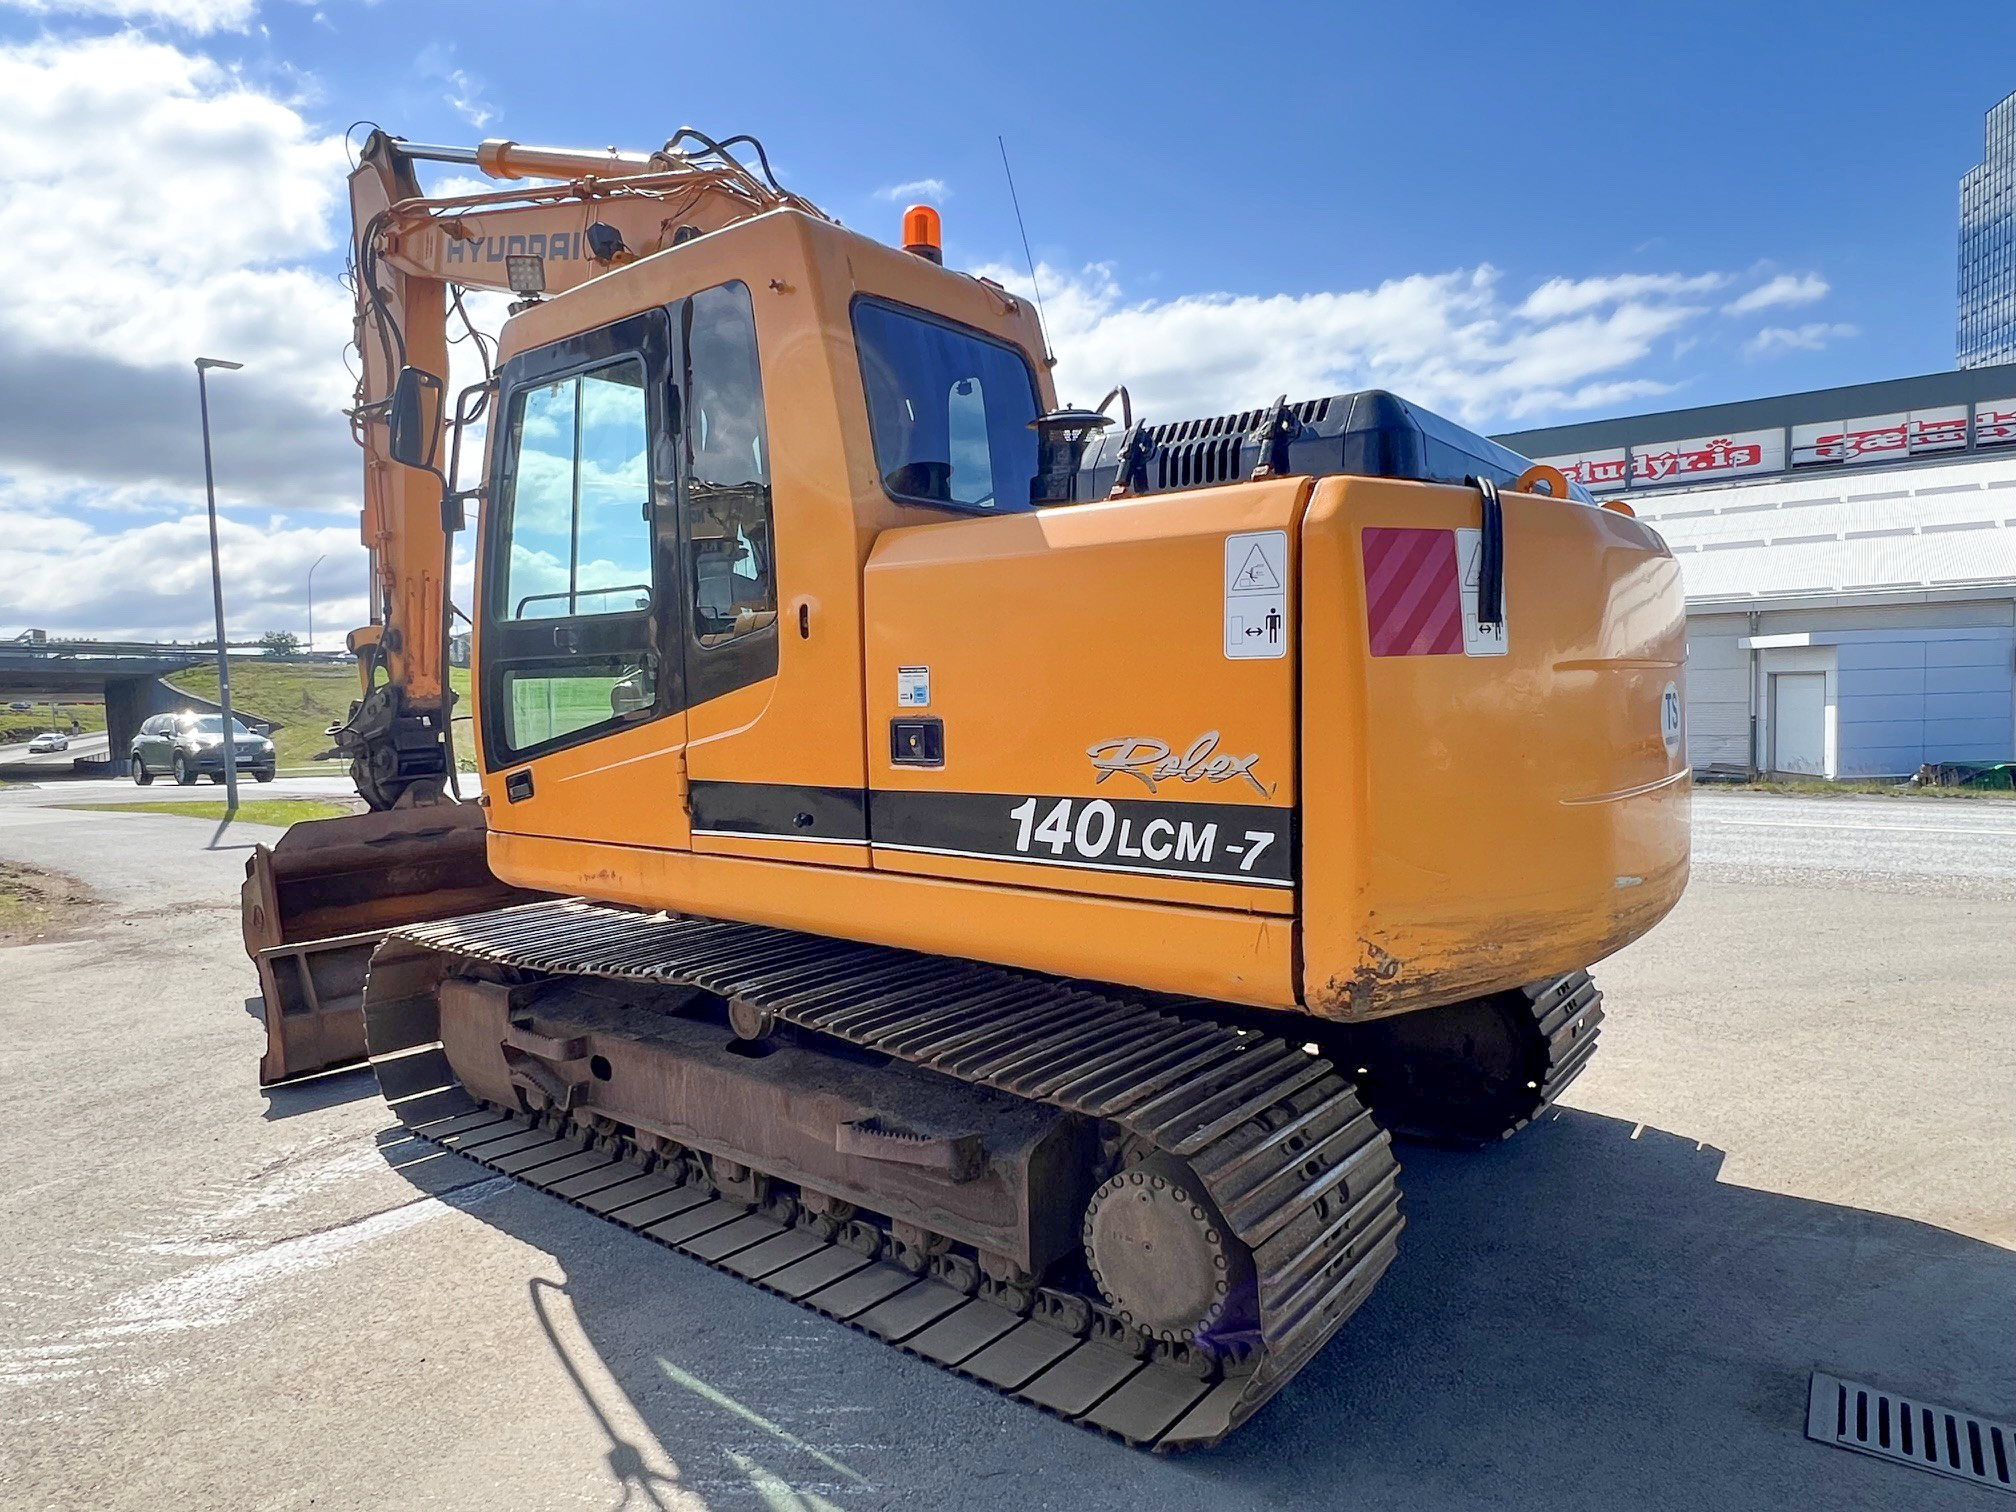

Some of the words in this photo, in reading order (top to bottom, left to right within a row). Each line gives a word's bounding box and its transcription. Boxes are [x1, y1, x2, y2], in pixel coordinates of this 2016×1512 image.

[447, 232, 581, 263] HYUNDAI
[1665, 692, 1679, 731] TS
[1086, 730, 1276, 800] Robex
